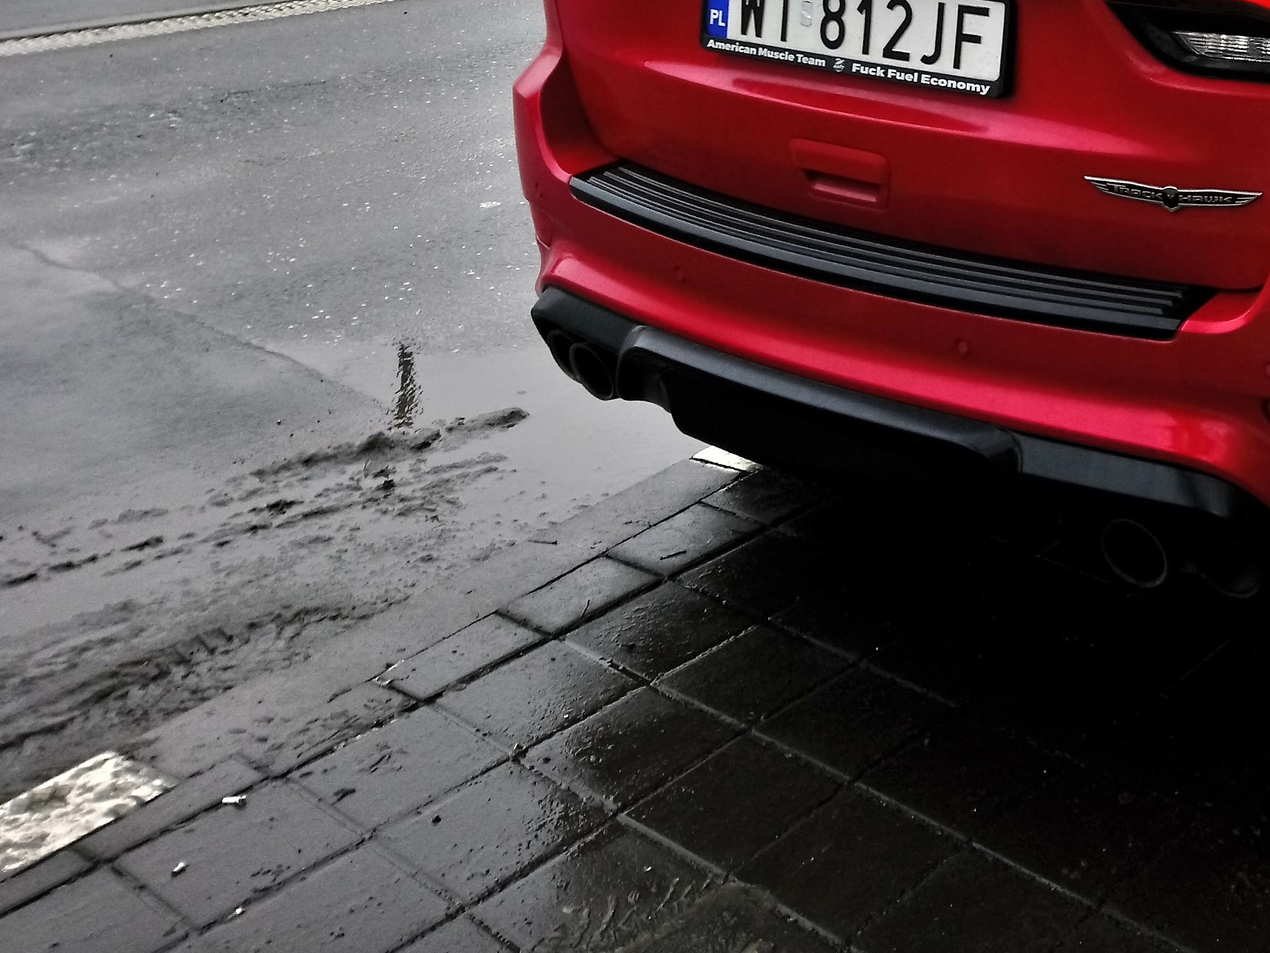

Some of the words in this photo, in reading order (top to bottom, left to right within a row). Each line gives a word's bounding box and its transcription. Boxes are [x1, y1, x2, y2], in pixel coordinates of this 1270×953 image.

[709, 8, 726, 27] PL
[706, 38, 757, 56] American
[758, 47, 795, 63] Muscle
[796, 53, 826, 68] Team
[851, 62, 886, 78] Fuck
[887, 68, 919, 84] Fuel
[920, 74, 991, 96] Economy
